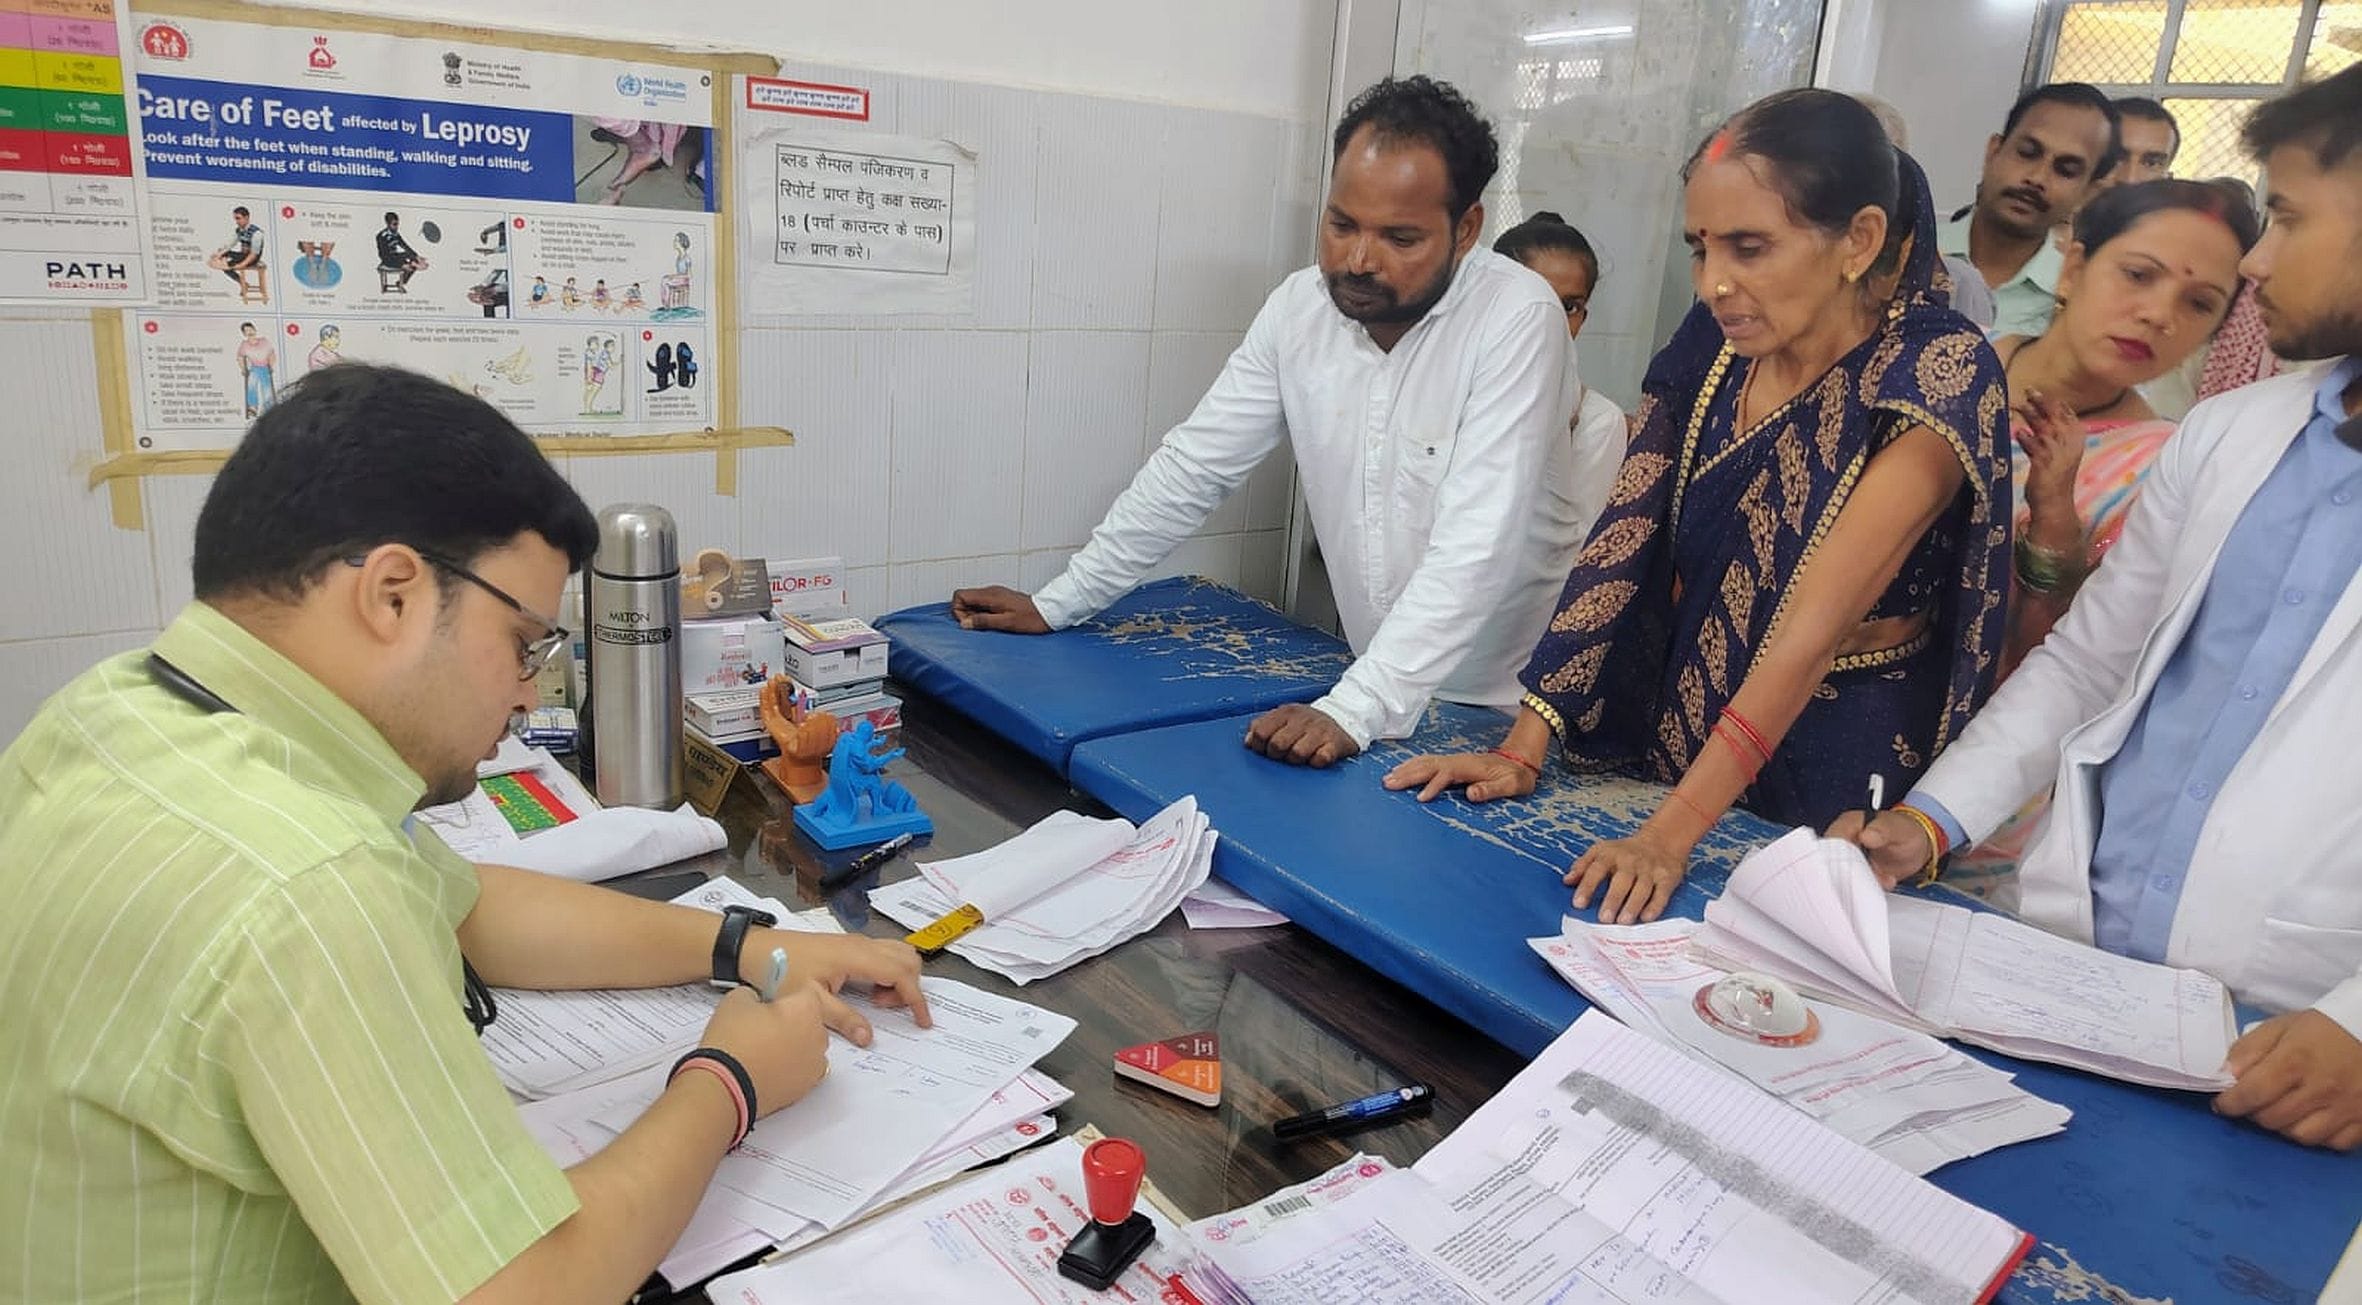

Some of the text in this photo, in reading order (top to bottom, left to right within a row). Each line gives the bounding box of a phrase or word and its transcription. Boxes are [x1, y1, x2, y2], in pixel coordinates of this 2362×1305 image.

[138, 88, 211, 122] Care
[221, 97, 253, 126] of
[263, 99, 335, 132] Feet
[341, 116, 398, 131] affected
[401, 119, 418, 134] by
[422, 113, 531, 152] Leprosy
[182, 133, 220, 148] after
[223, 136, 250, 151] the
[254, 136, 285, 153] feet
[287, 140, 328, 156] when
[332, 143, 400, 163] standing,
[401, 149, 457, 168] walking
[459, 155, 485, 168] and
[487, 155, 534, 173] sitting.
[205, 155, 287, 174] worsening
[288, 157, 305, 173] of
[307, 159, 392, 178] disabilities.
[780, 152, 808, 168] ब्लड
[920, 168, 929, 184] व
[780, 179, 815, 200] रिपोर्ट
[823, 187, 849, 202] प्राप्त
[856, 186, 875, 210] हेतु
[881, 194, 903, 208] कक्ष
[781, 215, 796, 228] 18
[895, 220, 907, 236] के
[914, 225, 943, 243] पास)
[780, 240, 797, 255] पर
[811, 243, 837, 259] प्राप्त
[47, 262, 126, 279] PATH
[608, 611, 651, 625] MILTON
